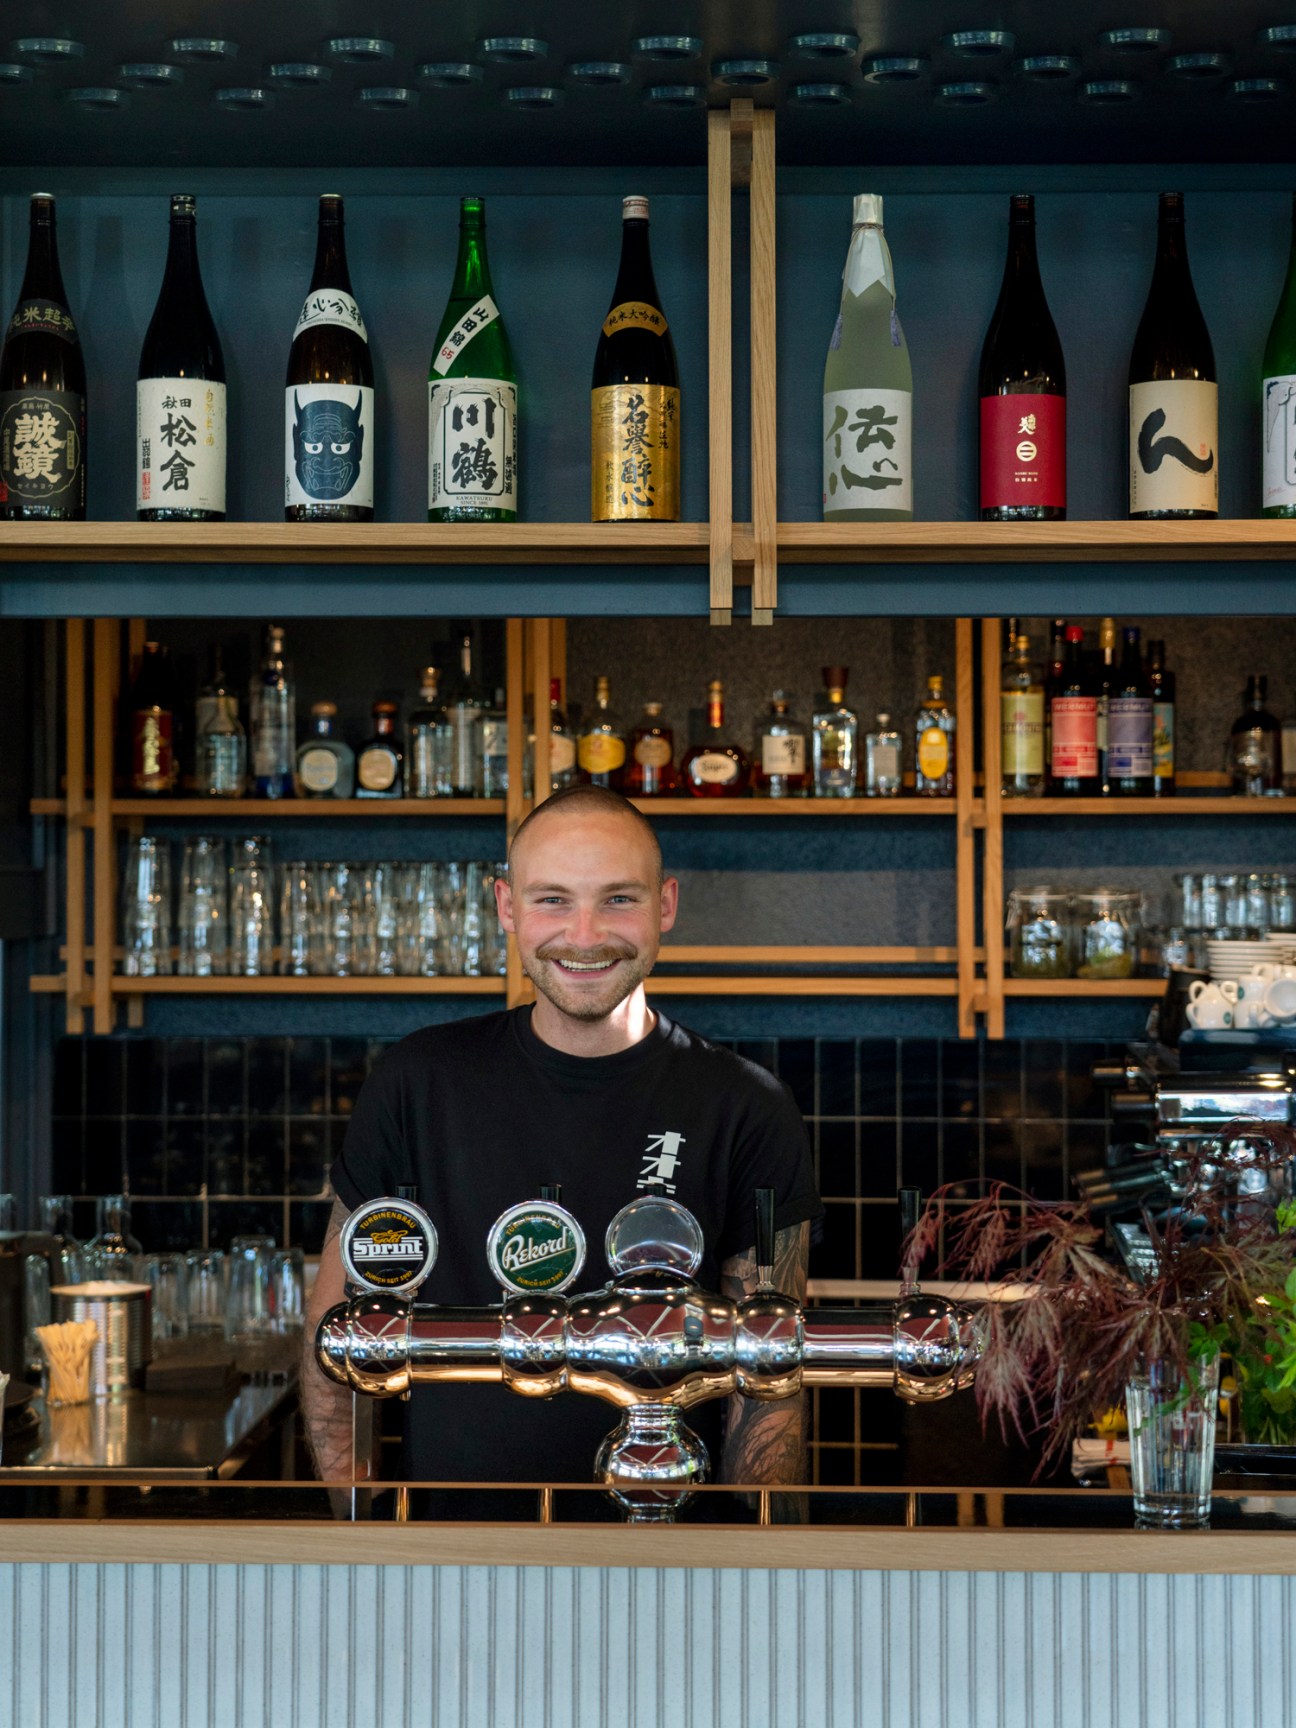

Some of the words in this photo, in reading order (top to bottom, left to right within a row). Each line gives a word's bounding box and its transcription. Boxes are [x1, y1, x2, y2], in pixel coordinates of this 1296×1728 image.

[449, 307, 489, 347] 山田錦
[441, 346, 455, 360] 65
[161, 395, 192, 409] 秋田
[160, 412, 197, 491] 松倉
[451, 397, 499, 490] 川鶴
[353, 1239, 423, 1258] Sprint
[502, 1226, 568, 1270] Rekord
